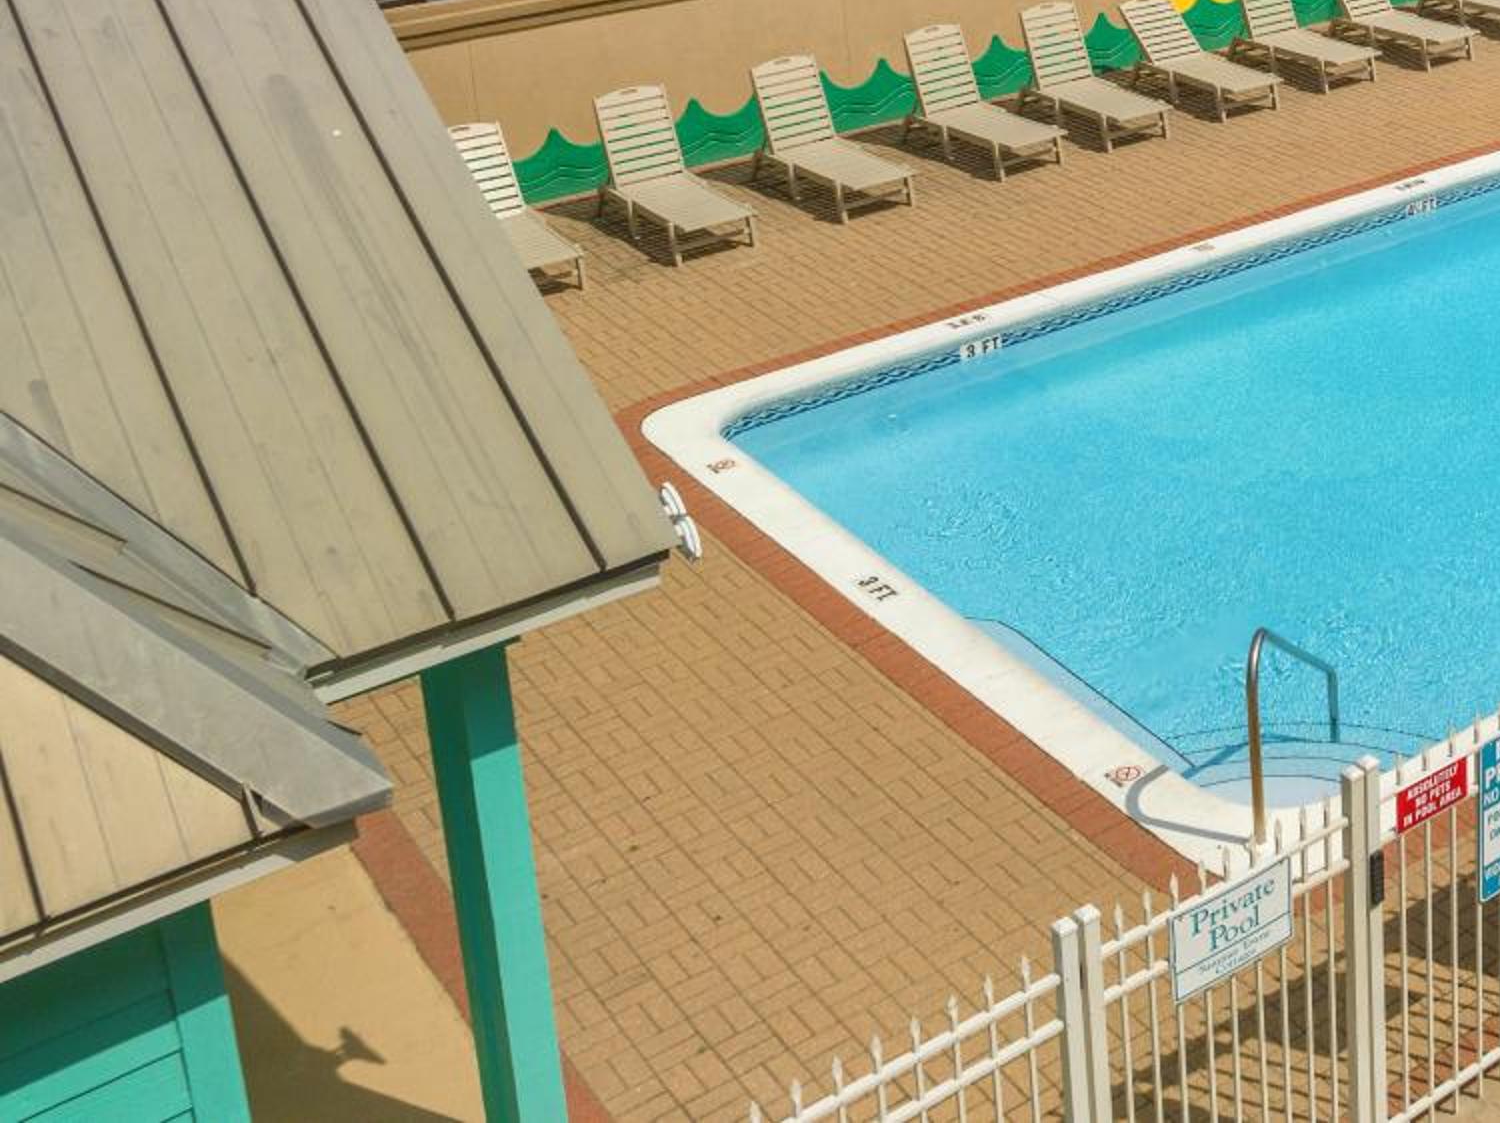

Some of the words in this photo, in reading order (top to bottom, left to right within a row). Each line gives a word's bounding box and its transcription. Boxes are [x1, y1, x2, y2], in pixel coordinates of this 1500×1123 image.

[982, 336, 999, 354] FT
[869, 584, 897, 602] FT
[1407, 761, 1458, 799] ABSOLUTELY
[1429, 779, 1451, 804] PETS
[1403, 812, 1413, 828] IN
[1415, 802, 1437, 822] POOL
[1439, 785, 1462, 807] AREA
[1483, 786, 1500, 806] NO
[1190, 878, 1275, 937] Private
[1209, 903, 1260, 951] Pool
